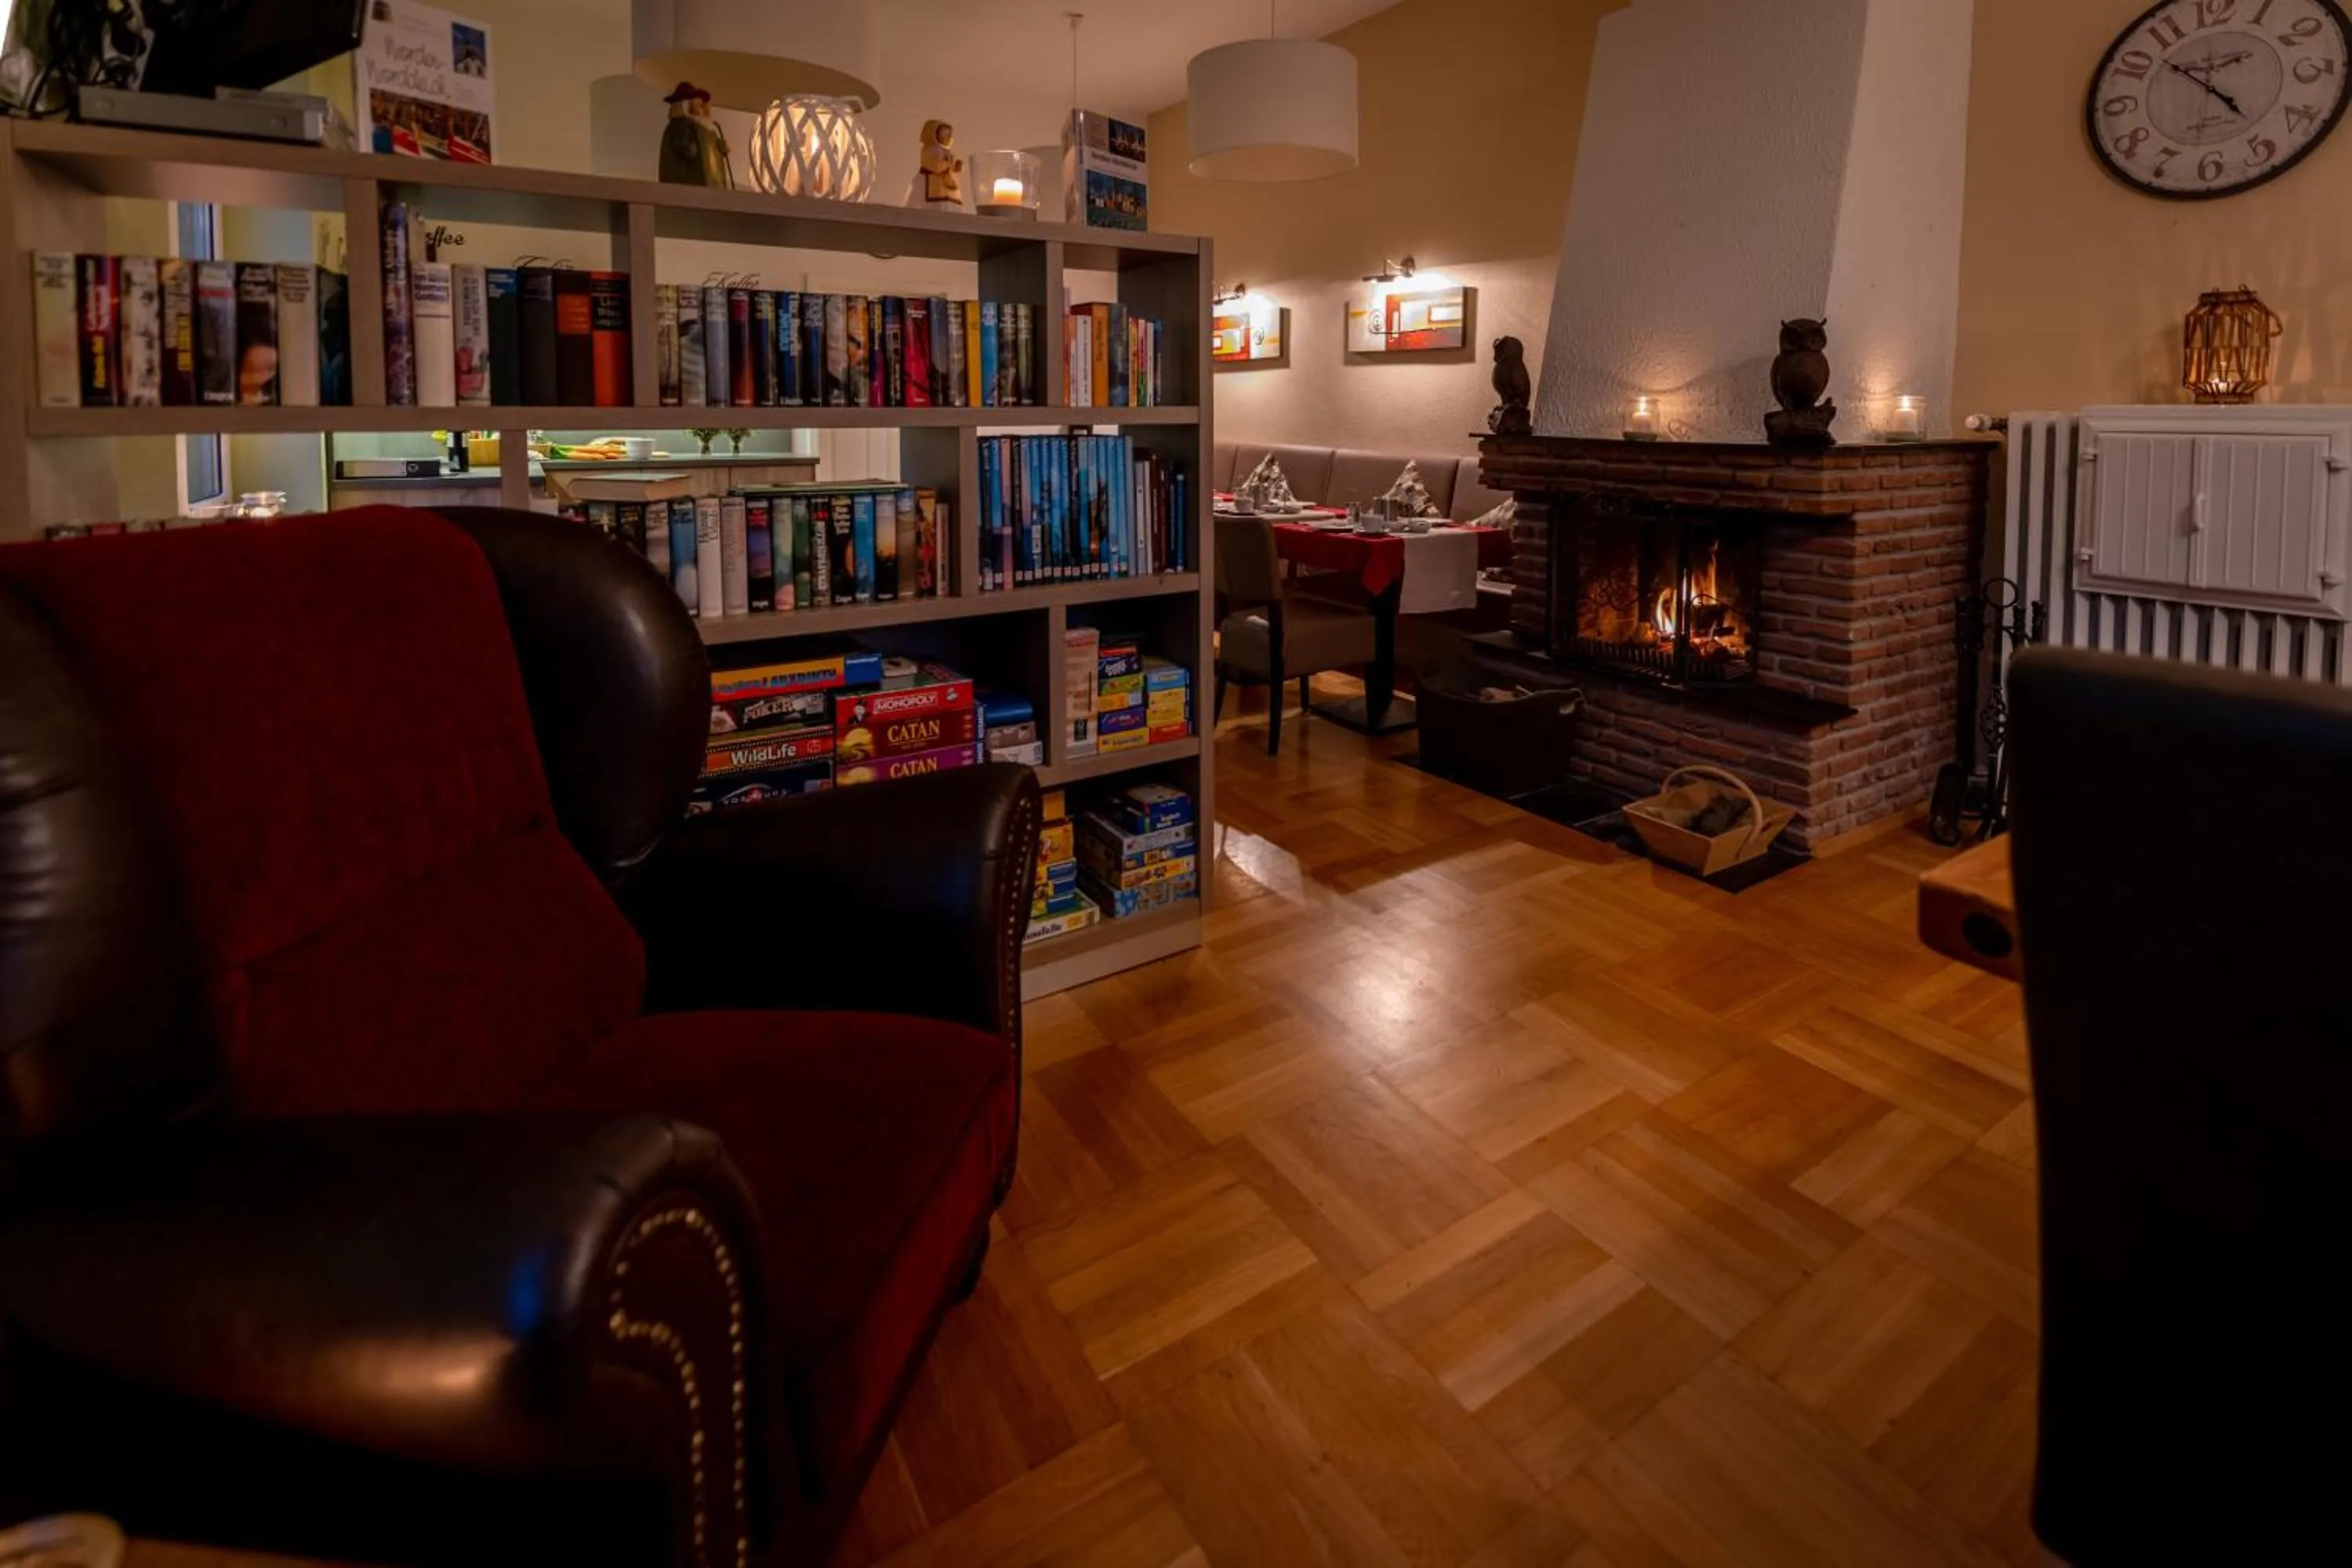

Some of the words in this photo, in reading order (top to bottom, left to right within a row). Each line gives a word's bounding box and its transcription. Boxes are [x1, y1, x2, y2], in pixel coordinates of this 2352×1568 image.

[2147, 15, 2187, 51] 11
[2278, 16, 2323, 47] 2
[2112, 49, 2154, 82] 10
[2293, 56, 2335, 85] 3
[2103, 95, 2138, 117] 9
[2284, 103, 2322, 134] 4
[2114, 126, 2151, 160] 8
[2244, 134, 2277, 168] 5
[2152, 147, 2182, 178] 7
[2198, 151, 2223, 183] 6
[426, 225, 466, 247] offee
[876, 693, 937, 712] MONOPOLY
[887, 719, 941, 742] CATAN
[731, 743, 797, 767] WildLife
[889, 757, 938, 779] CATAN
